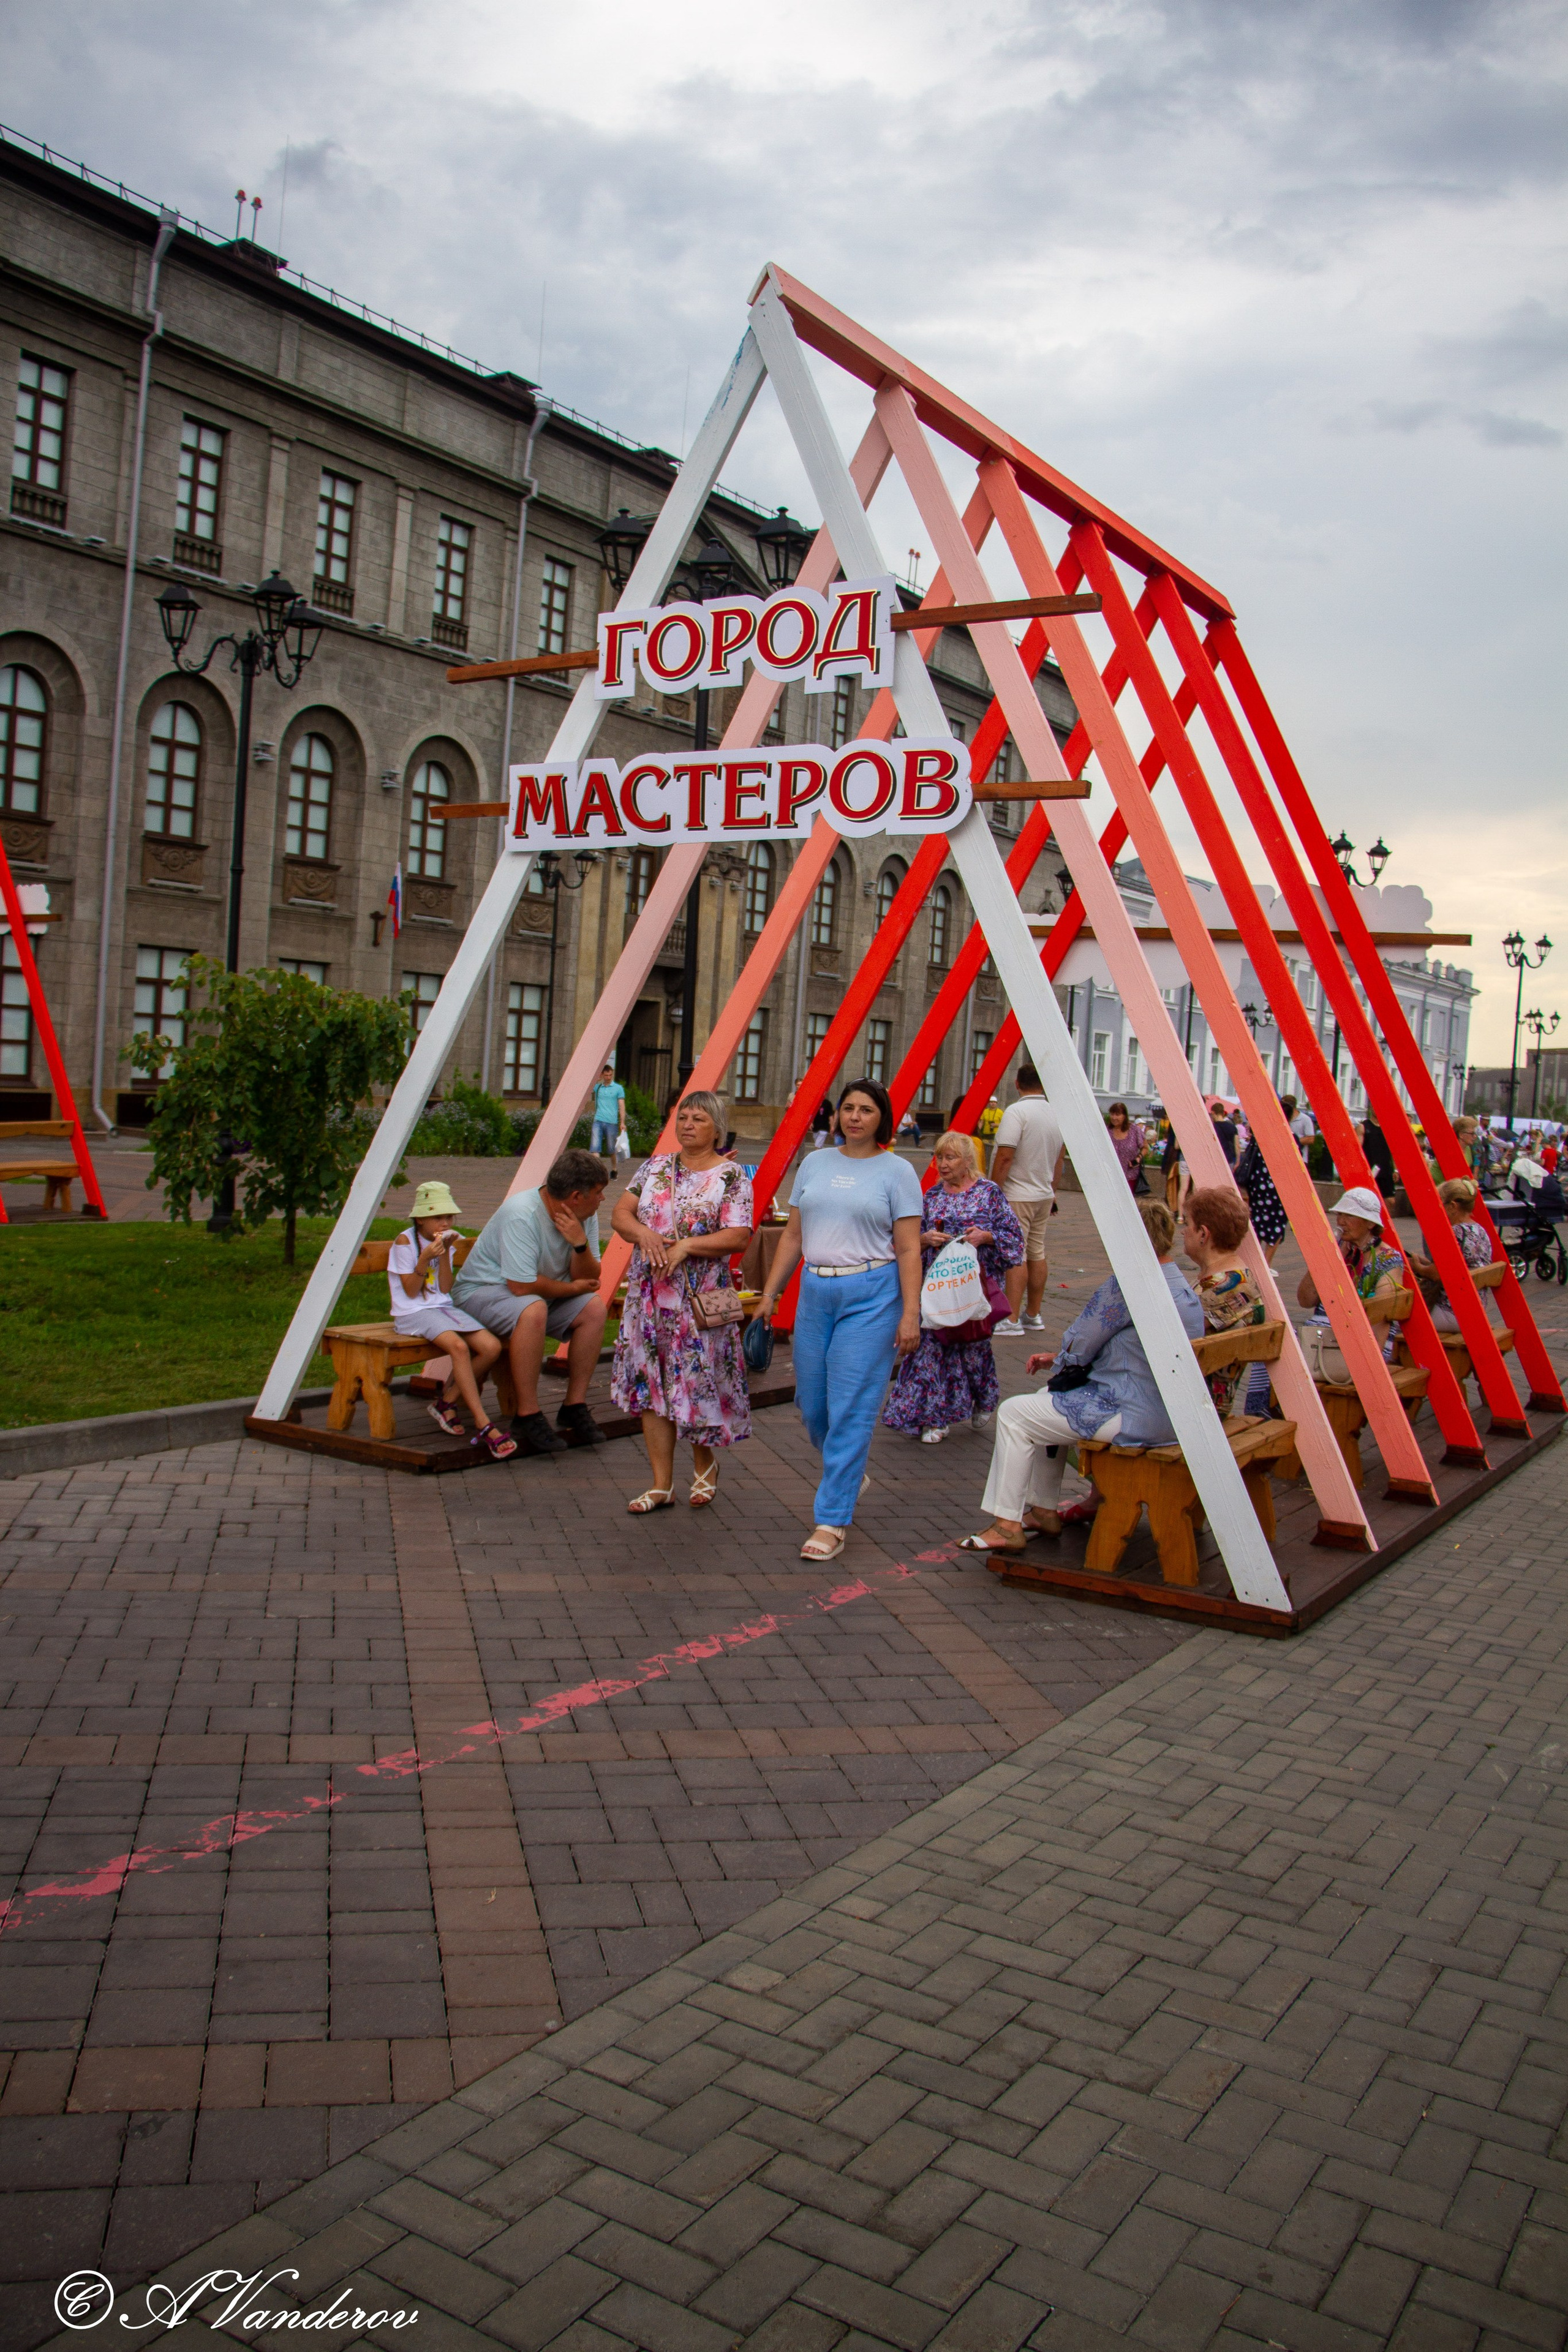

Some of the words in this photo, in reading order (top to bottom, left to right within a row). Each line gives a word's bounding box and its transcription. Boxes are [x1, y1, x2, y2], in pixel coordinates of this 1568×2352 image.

[602, 589, 880, 686] ГОРОД
[512, 749, 959, 838] МАСТЕРОВ
[928, 1268, 949, 1279] ЧТО
